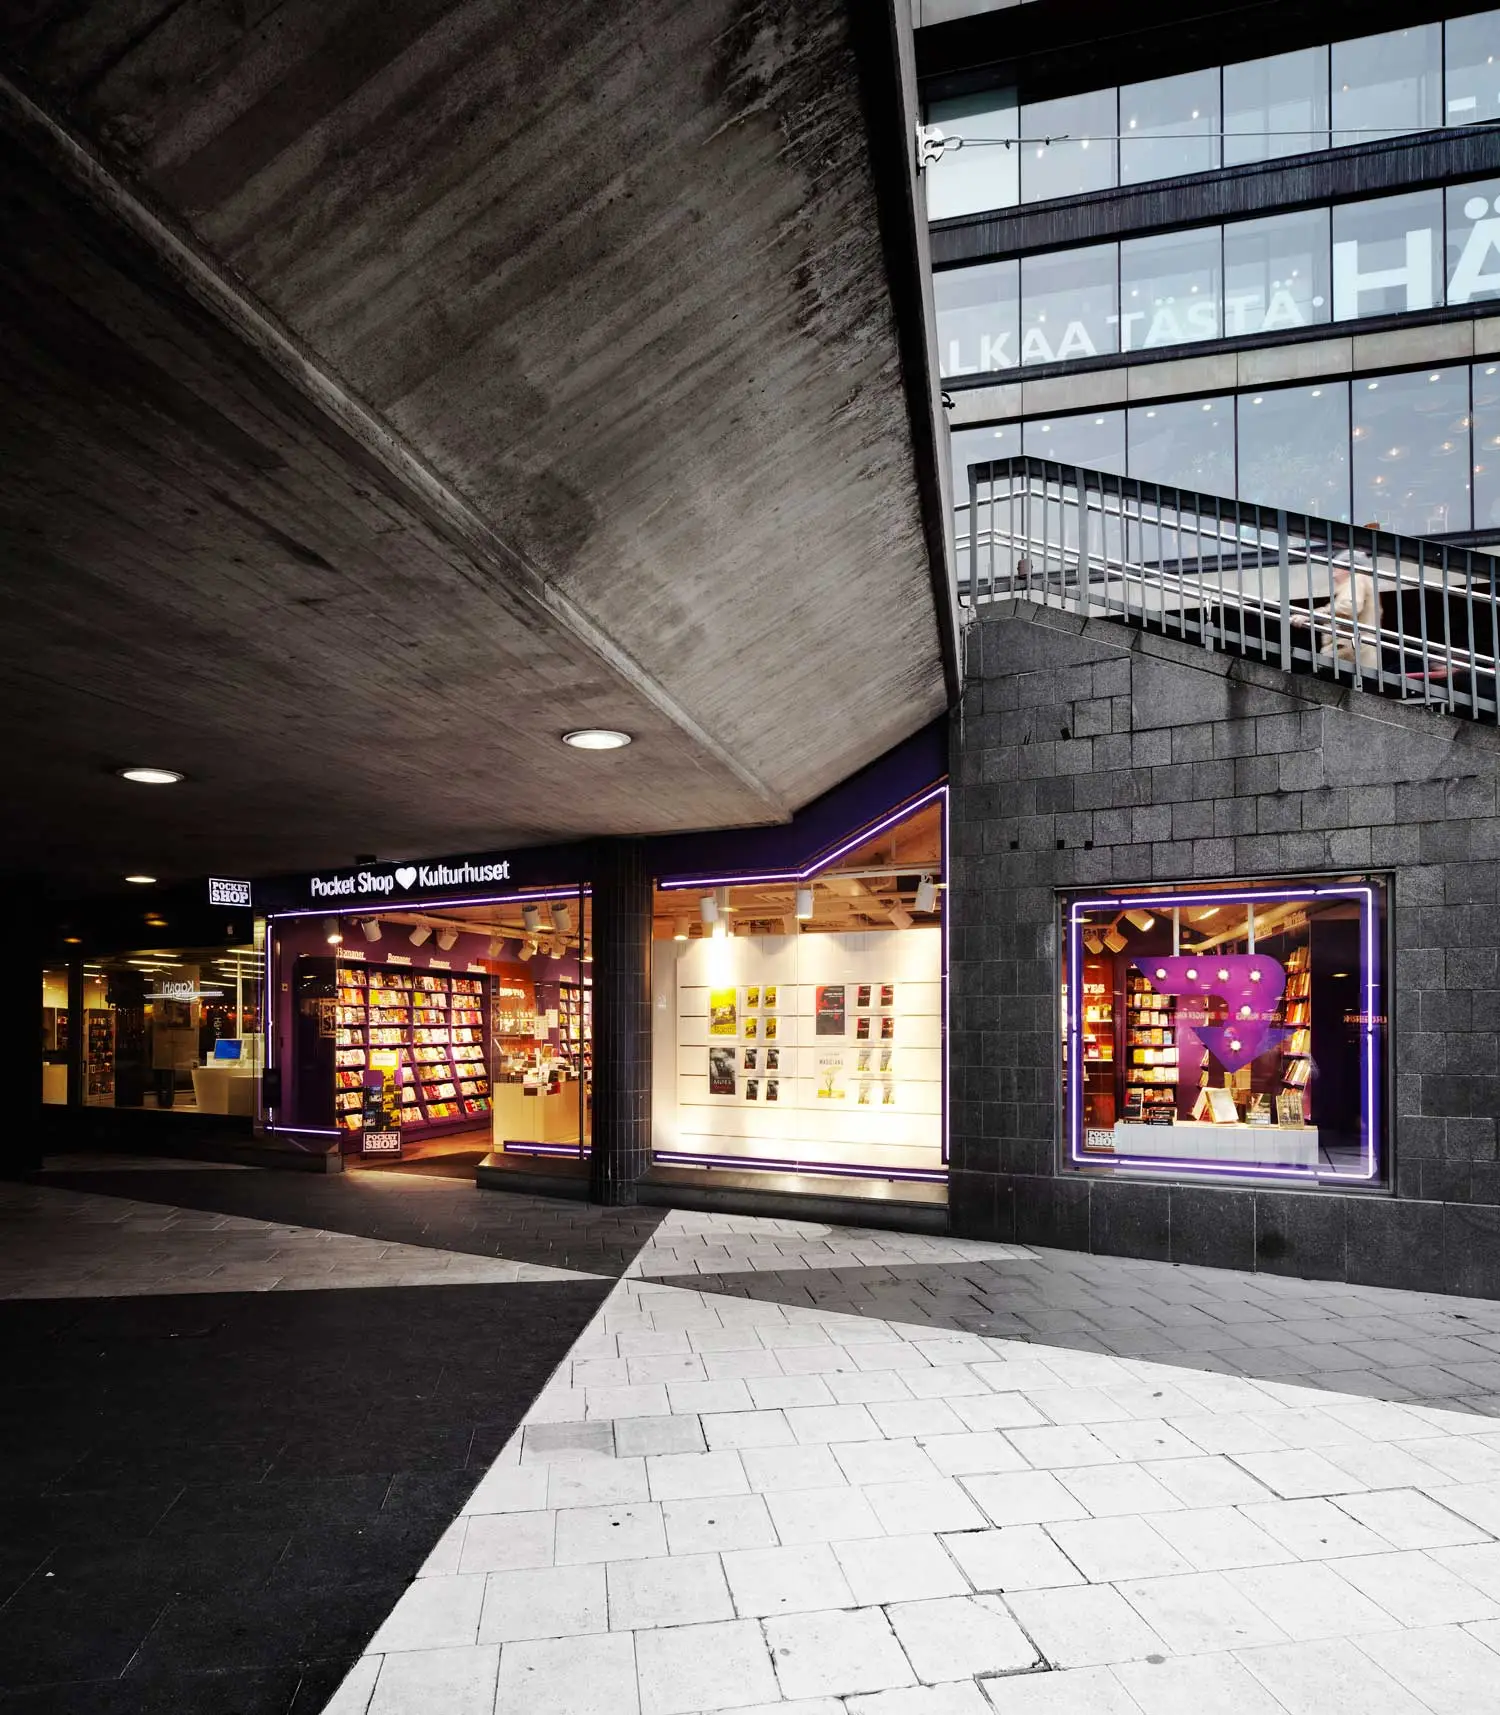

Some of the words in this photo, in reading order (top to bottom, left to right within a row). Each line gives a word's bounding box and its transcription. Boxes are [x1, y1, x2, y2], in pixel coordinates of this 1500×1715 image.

[940, 321, 1098, 376] LKAA
[1106, 278, 1306, 353] TÄSTÄ
[311, 875, 356, 897] Pocket
[357, 872, 394, 895] Shop
[419, 860, 510, 887] Kulturhuset
[212, 881, 249, 892] POCKET
[212, 890, 249, 903] SHOP
[365, 1140, 398, 1149] SHOP
